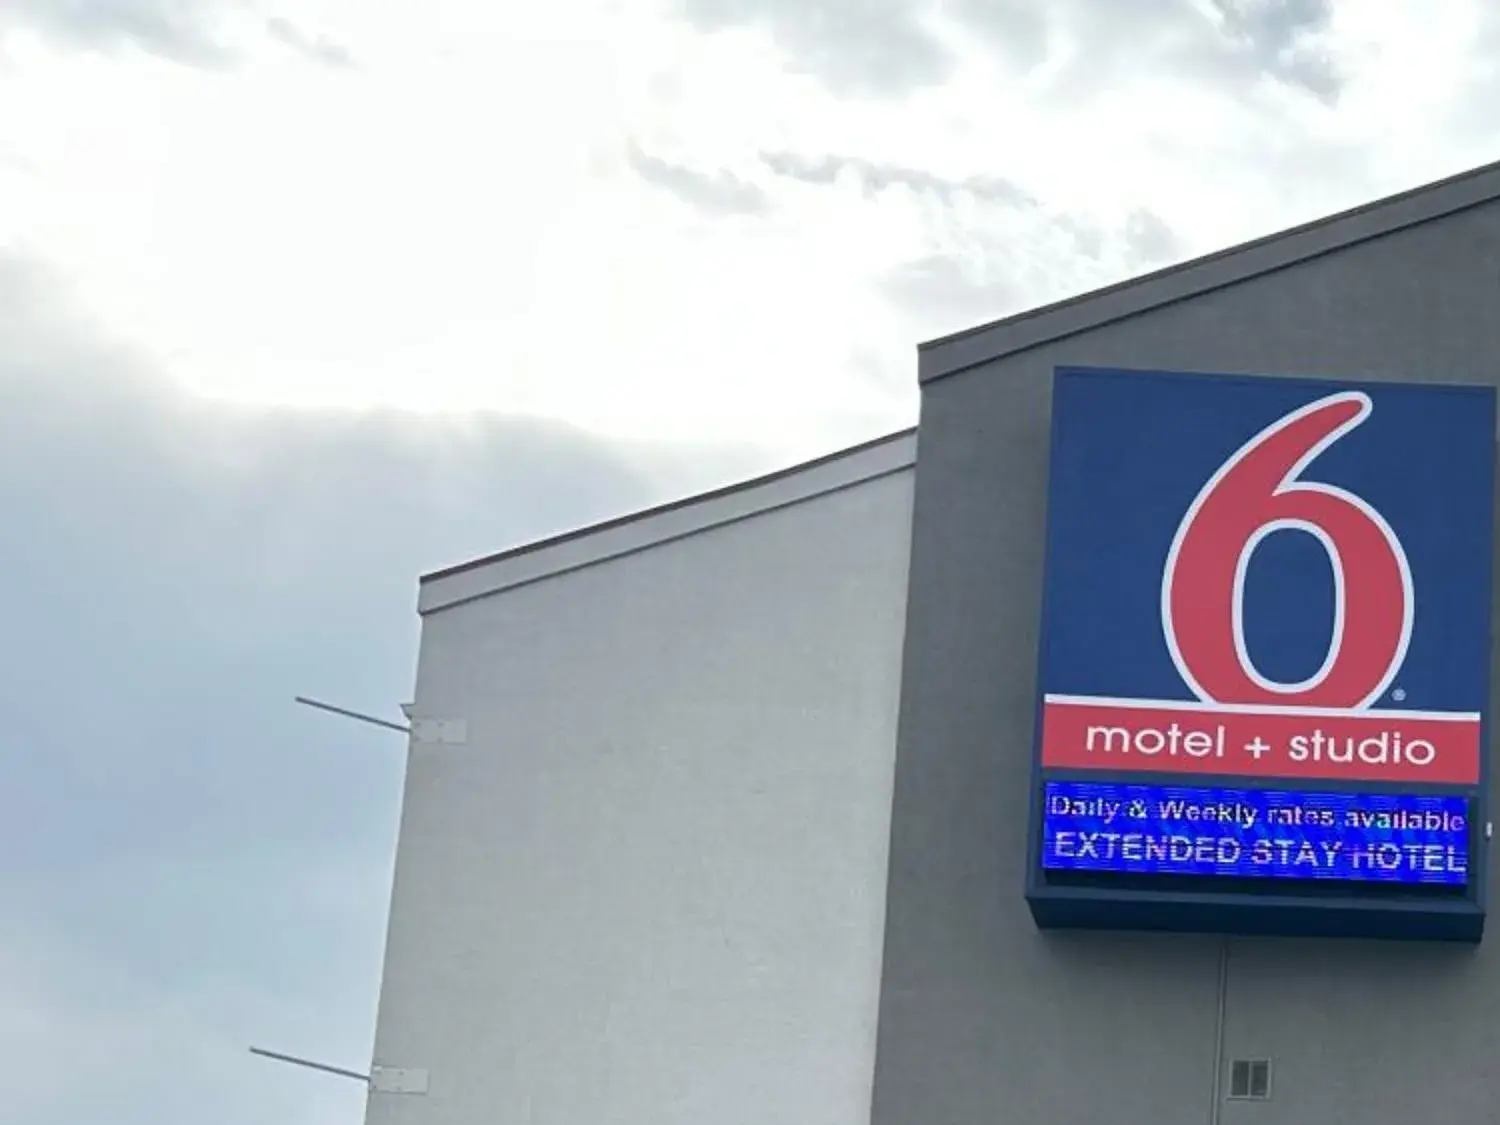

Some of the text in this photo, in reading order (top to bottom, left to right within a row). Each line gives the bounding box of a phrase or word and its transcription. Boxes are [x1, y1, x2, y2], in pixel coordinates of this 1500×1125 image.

[1161, 390, 1415, 712] 6
[1085, 723, 1225, 758] motel
[1289, 731, 1436, 765] studio
[1051, 795, 1466, 832] Daily & Weekly rates available
[1054, 831, 1468, 873] EXTENDED STAY HOTEL
